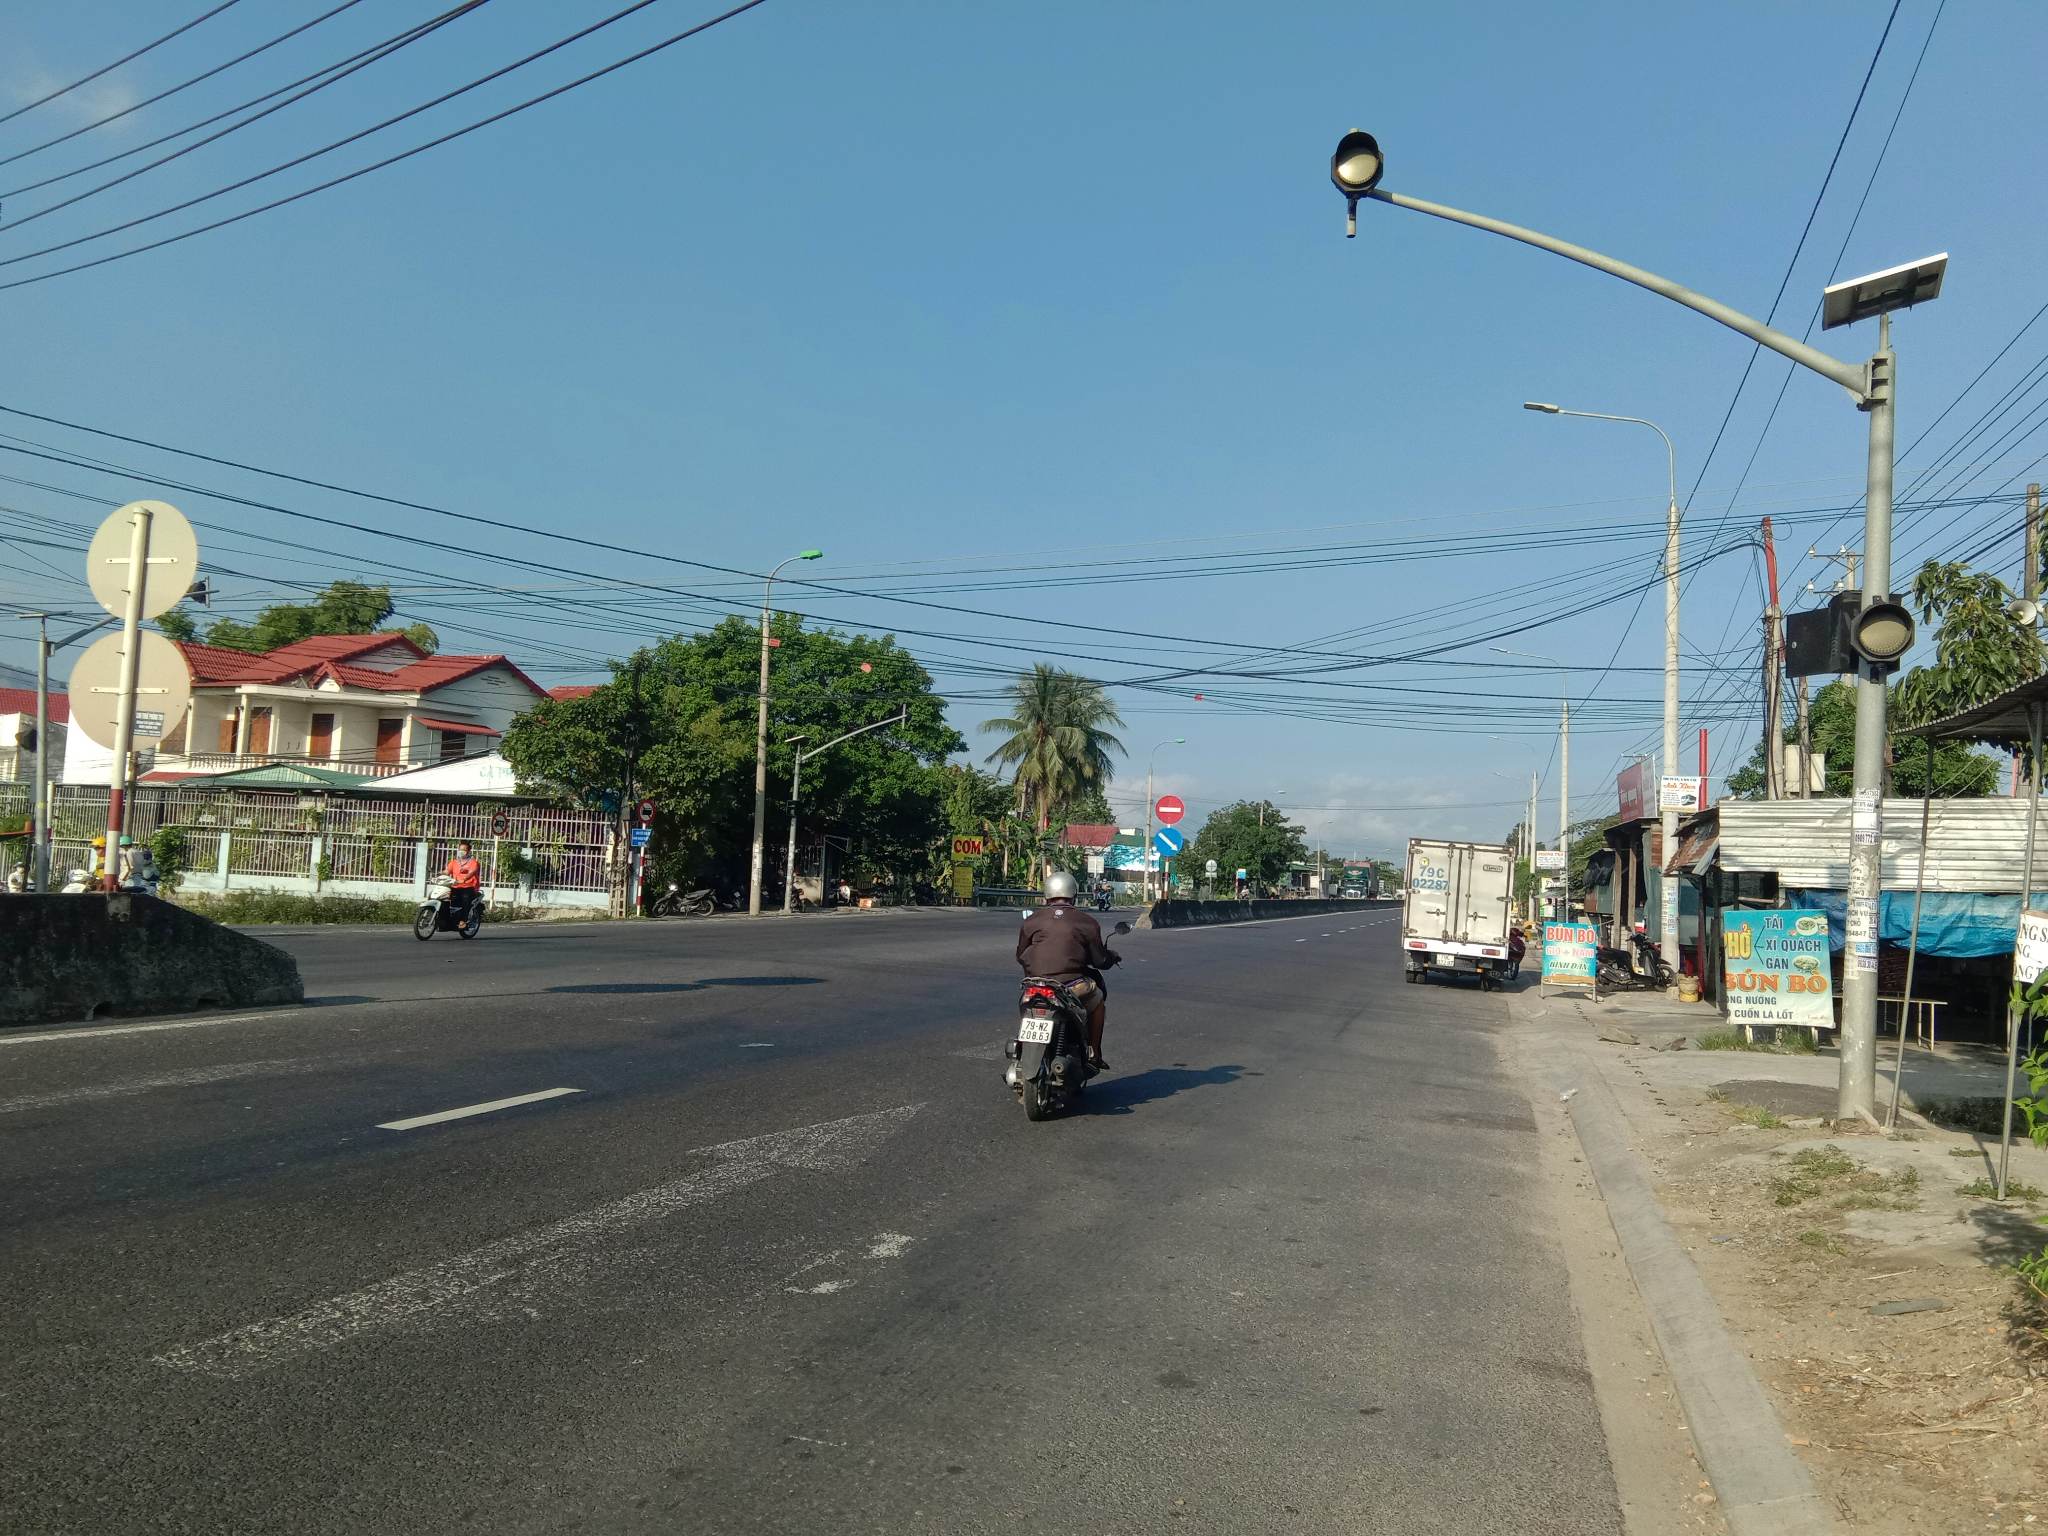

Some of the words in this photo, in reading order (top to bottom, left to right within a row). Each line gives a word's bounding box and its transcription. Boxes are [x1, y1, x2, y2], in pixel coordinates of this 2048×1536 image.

[1420, 866, 1445, 878] 79C
[1412, 879, 1449, 891] 02287
[1546, 924, 1574, 943] BÚN
[1577, 926, 1596, 944] BÒ
[2040, 927, 2048, 943] S
[1781, 938, 1821, 952] QUÁCH
[1726, 968, 1779, 993] BÚN
[1788, 970, 1828, 994] BÒ
[1020, 1030, 1050, 1042] 208.63
